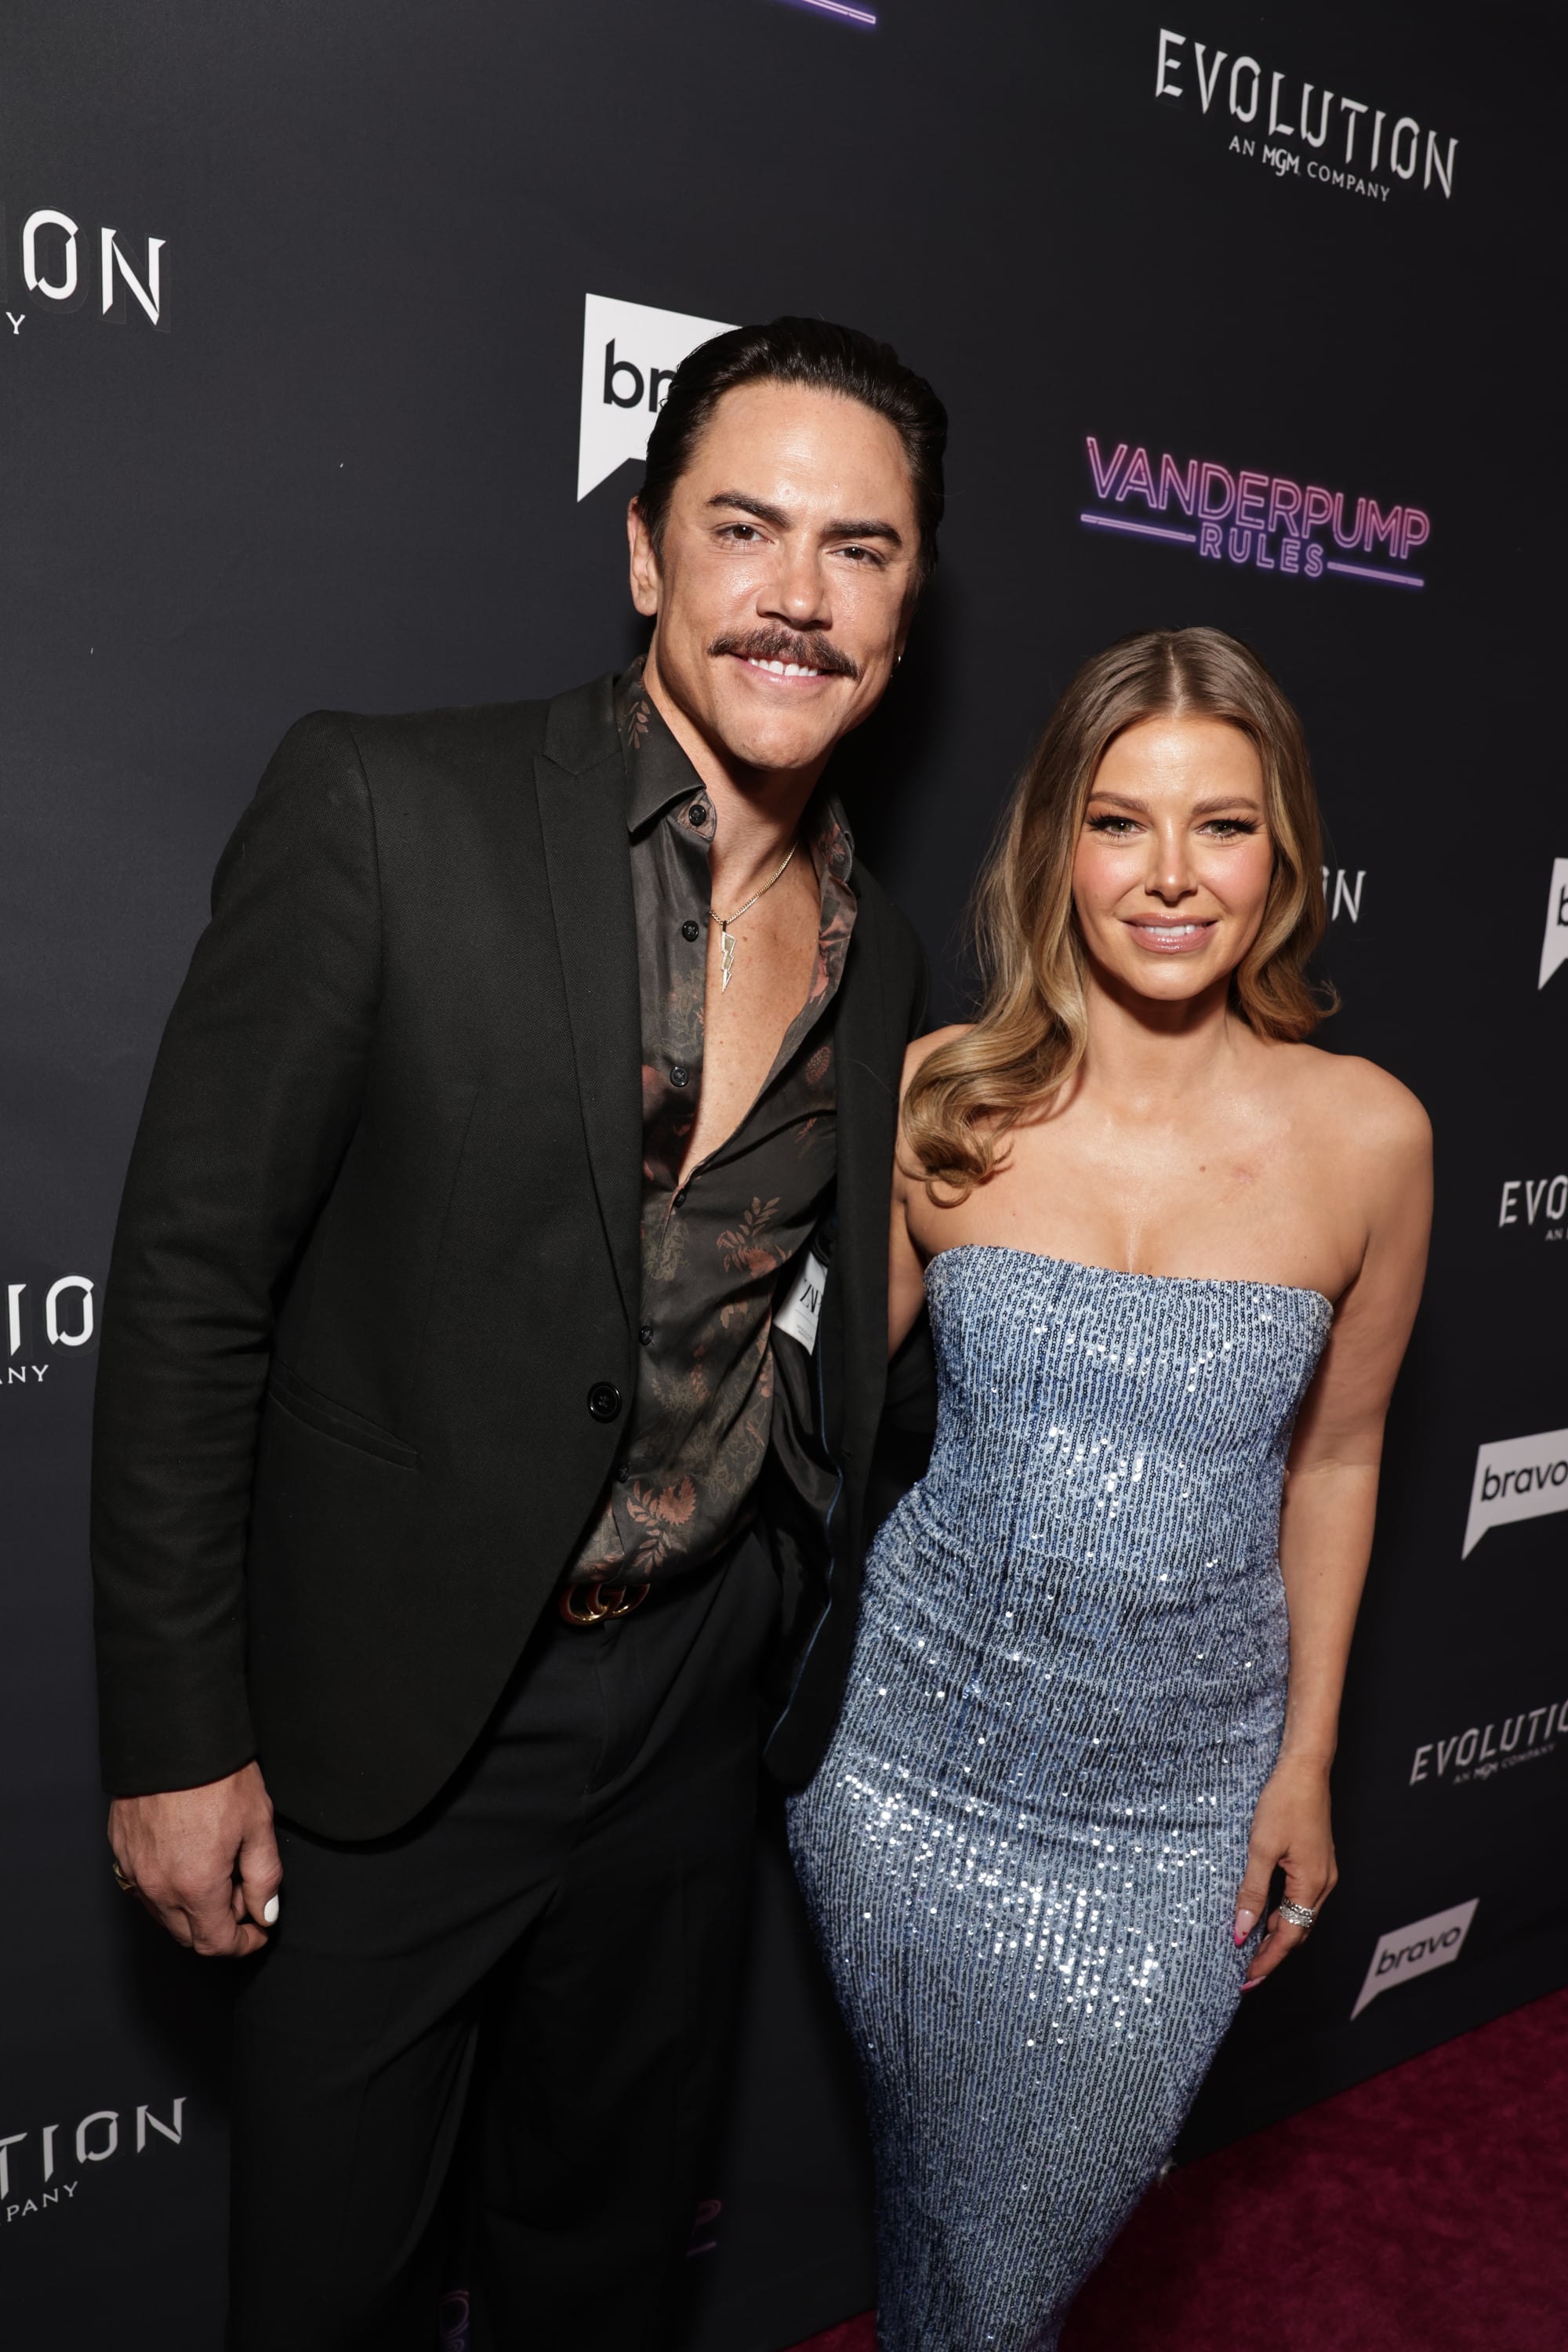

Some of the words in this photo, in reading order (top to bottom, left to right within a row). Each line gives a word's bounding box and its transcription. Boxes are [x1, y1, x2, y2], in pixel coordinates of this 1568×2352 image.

[1156, 28, 1459, 199] EVOLUTION
[1229, 135, 1255, 157] AN
[1307, 161, 1390, 201] COMPANY
[1086, 436, 1430, 559] VANDERPUMP
[1200, 522, 1324, 577] RULES
[1481, 1460, 1568, 1502] bravo
[1375, 1926, 1461, 1976] bravo
